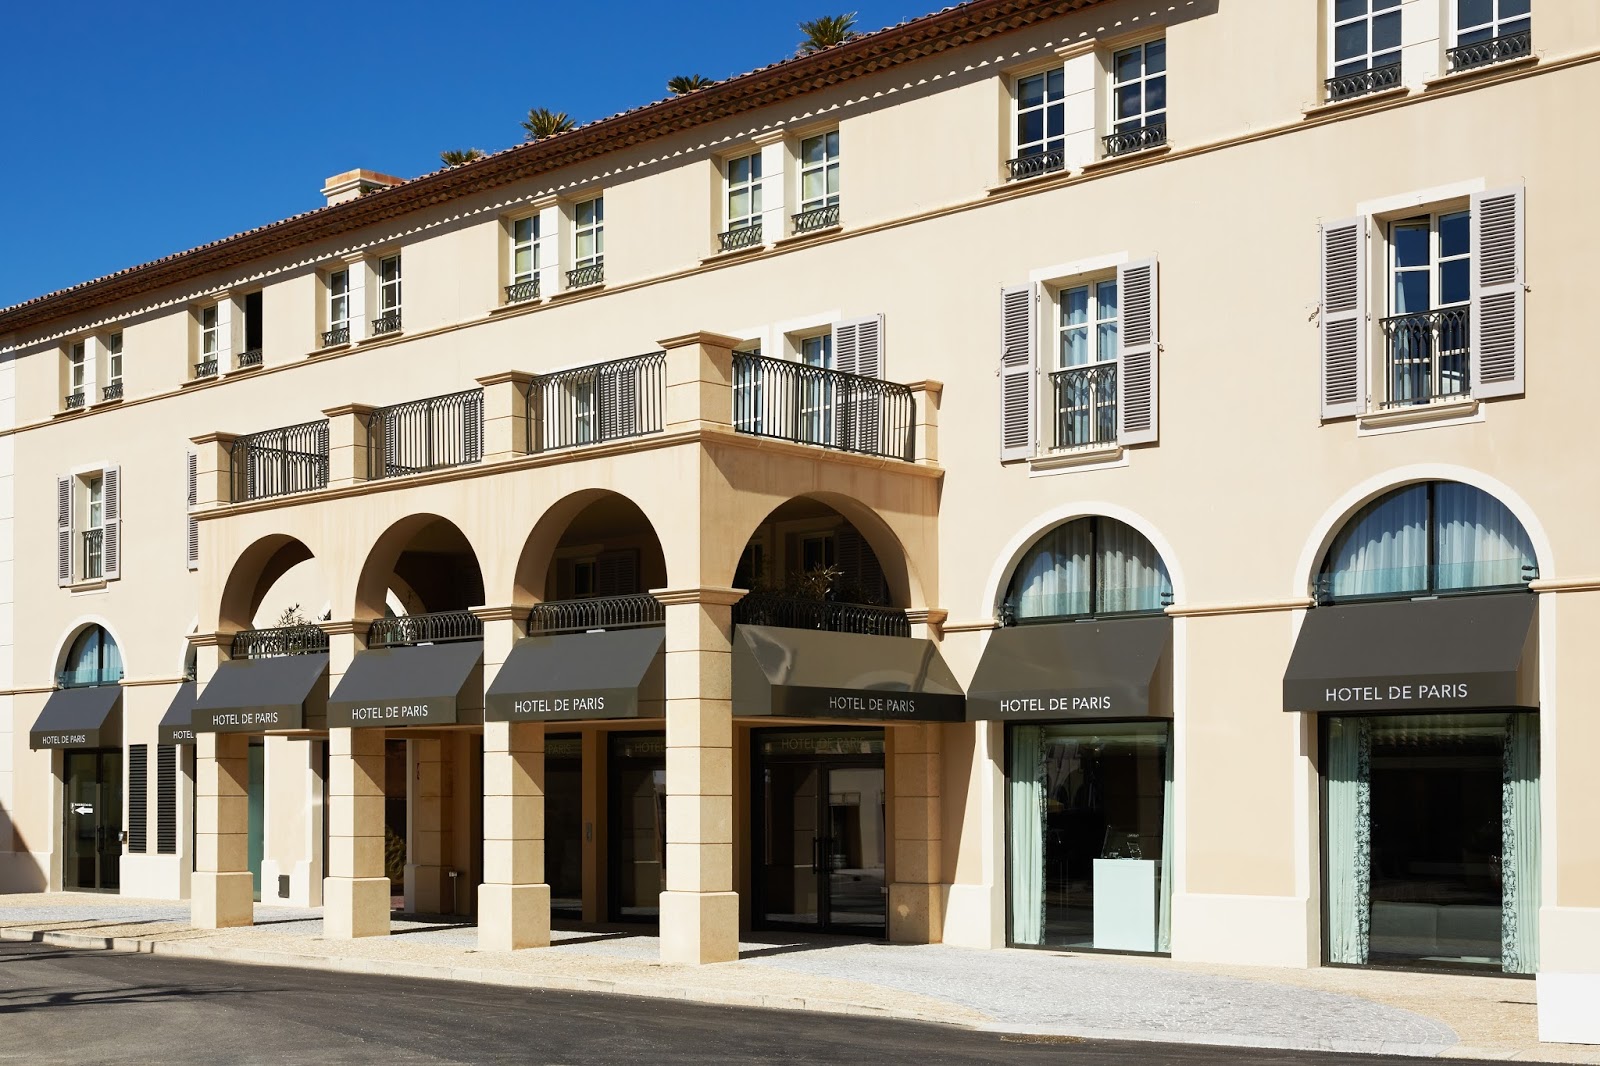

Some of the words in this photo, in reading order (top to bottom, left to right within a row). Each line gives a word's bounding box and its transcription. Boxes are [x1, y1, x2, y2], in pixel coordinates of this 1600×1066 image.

[1326, 687, 1382, 702] HOTEL
[1389, 686, 1412, 699] DE
[1418, 684, 1467, 698] PARIS
[513, 699, 551, 713] HOTEL
[555, 698, 569, 711] DE
[573, 697, 604, 710] PARIS
[829, 696, 866, 710] HOTEL
[869, 698, 883, 711] DE
[886, 699, 915, 712] PARIS
[1000, 698, 1045, 712] HOTEL
[1049, 698, 1067, 711] DE
[1072, 696, 1111, 710] PARIS
[212, 714, 239, 725] HOTEL
[242, 713, 253, 724] DE
[255, 712, 278, 723] PARIS
[352, 707, 383, 720] HOTEL
[386, 706, 398, 718] DE
[402, 705, 428, 717] PARIS
[42, 736, 60, 745] HOTEL
[61, 735, 69, 743] DE
[70, 734, 85, 743] PARIS
[172, 730, 194, 739] HOTEL
